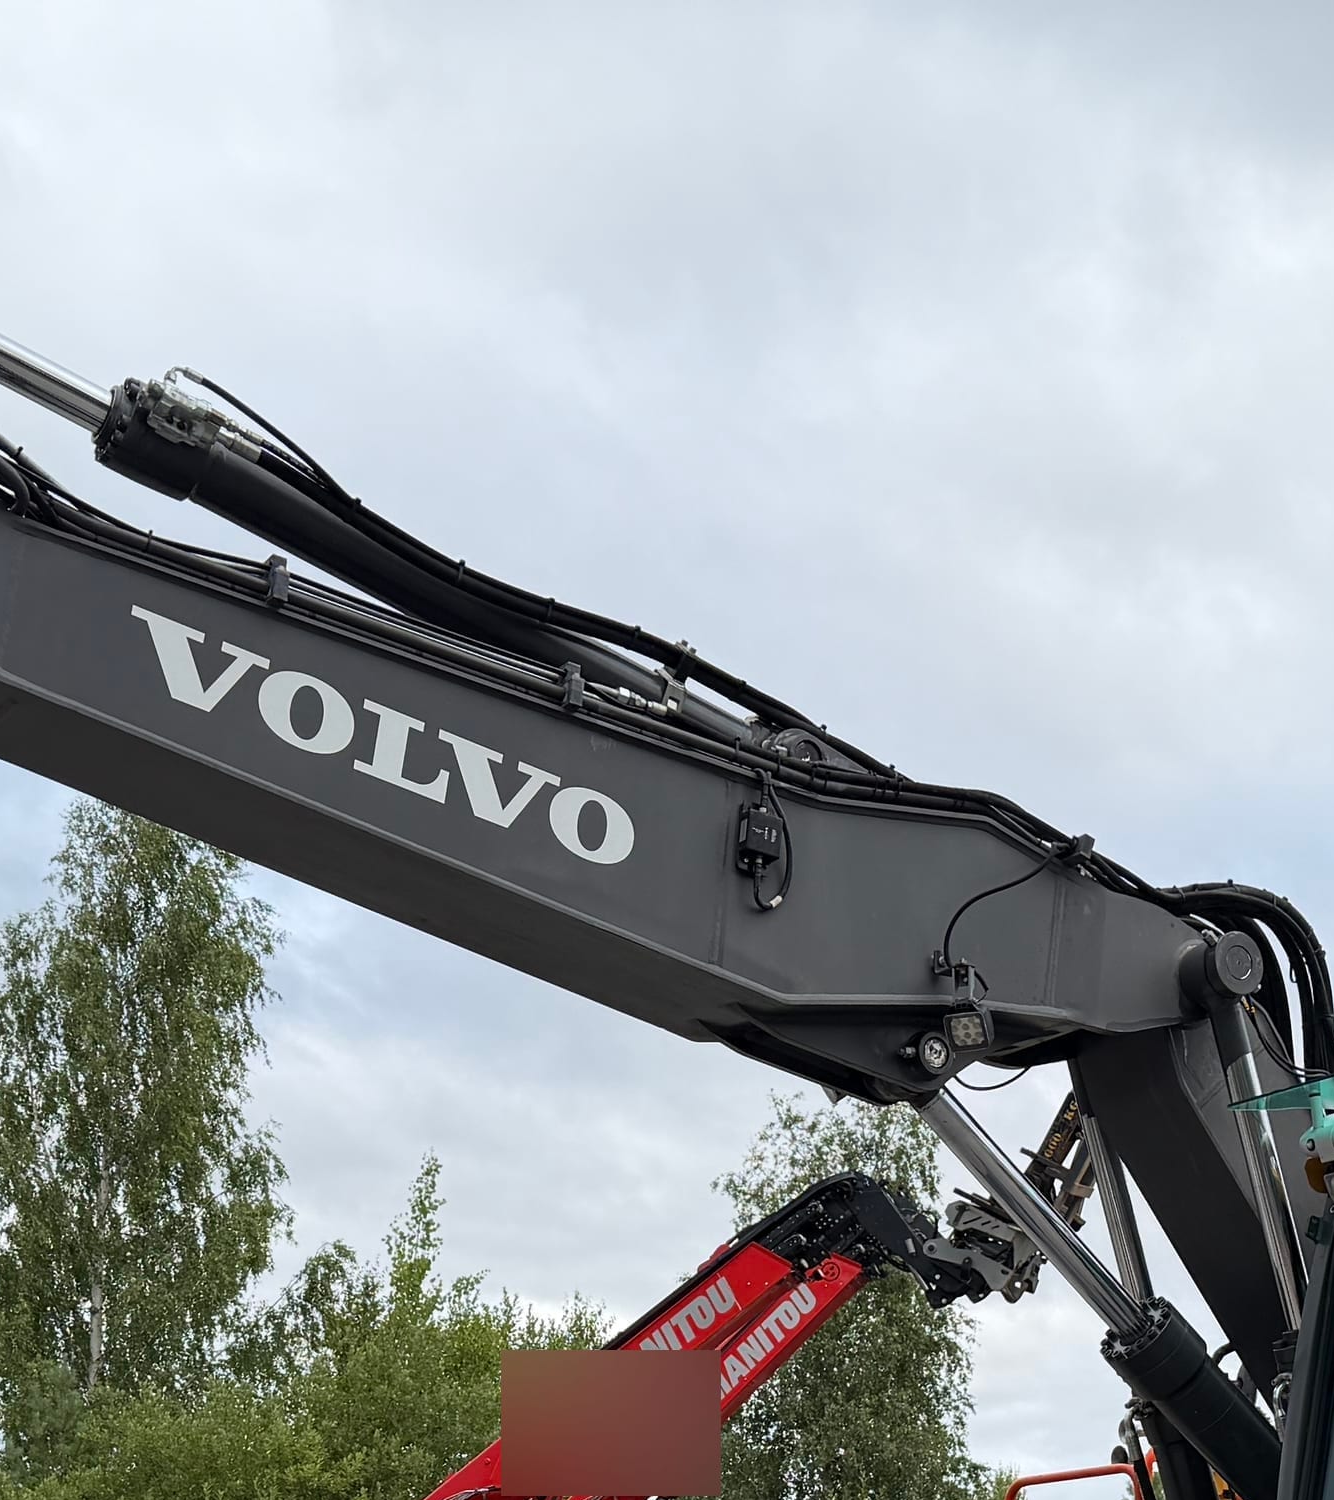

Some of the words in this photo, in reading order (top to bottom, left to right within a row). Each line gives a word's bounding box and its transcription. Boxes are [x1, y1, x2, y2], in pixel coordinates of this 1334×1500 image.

[131, 604, 635, 865] VOLVO
[639, 1276, 737, 1350] NITOU
[721, 1283, 817, 1400] ANITOU
